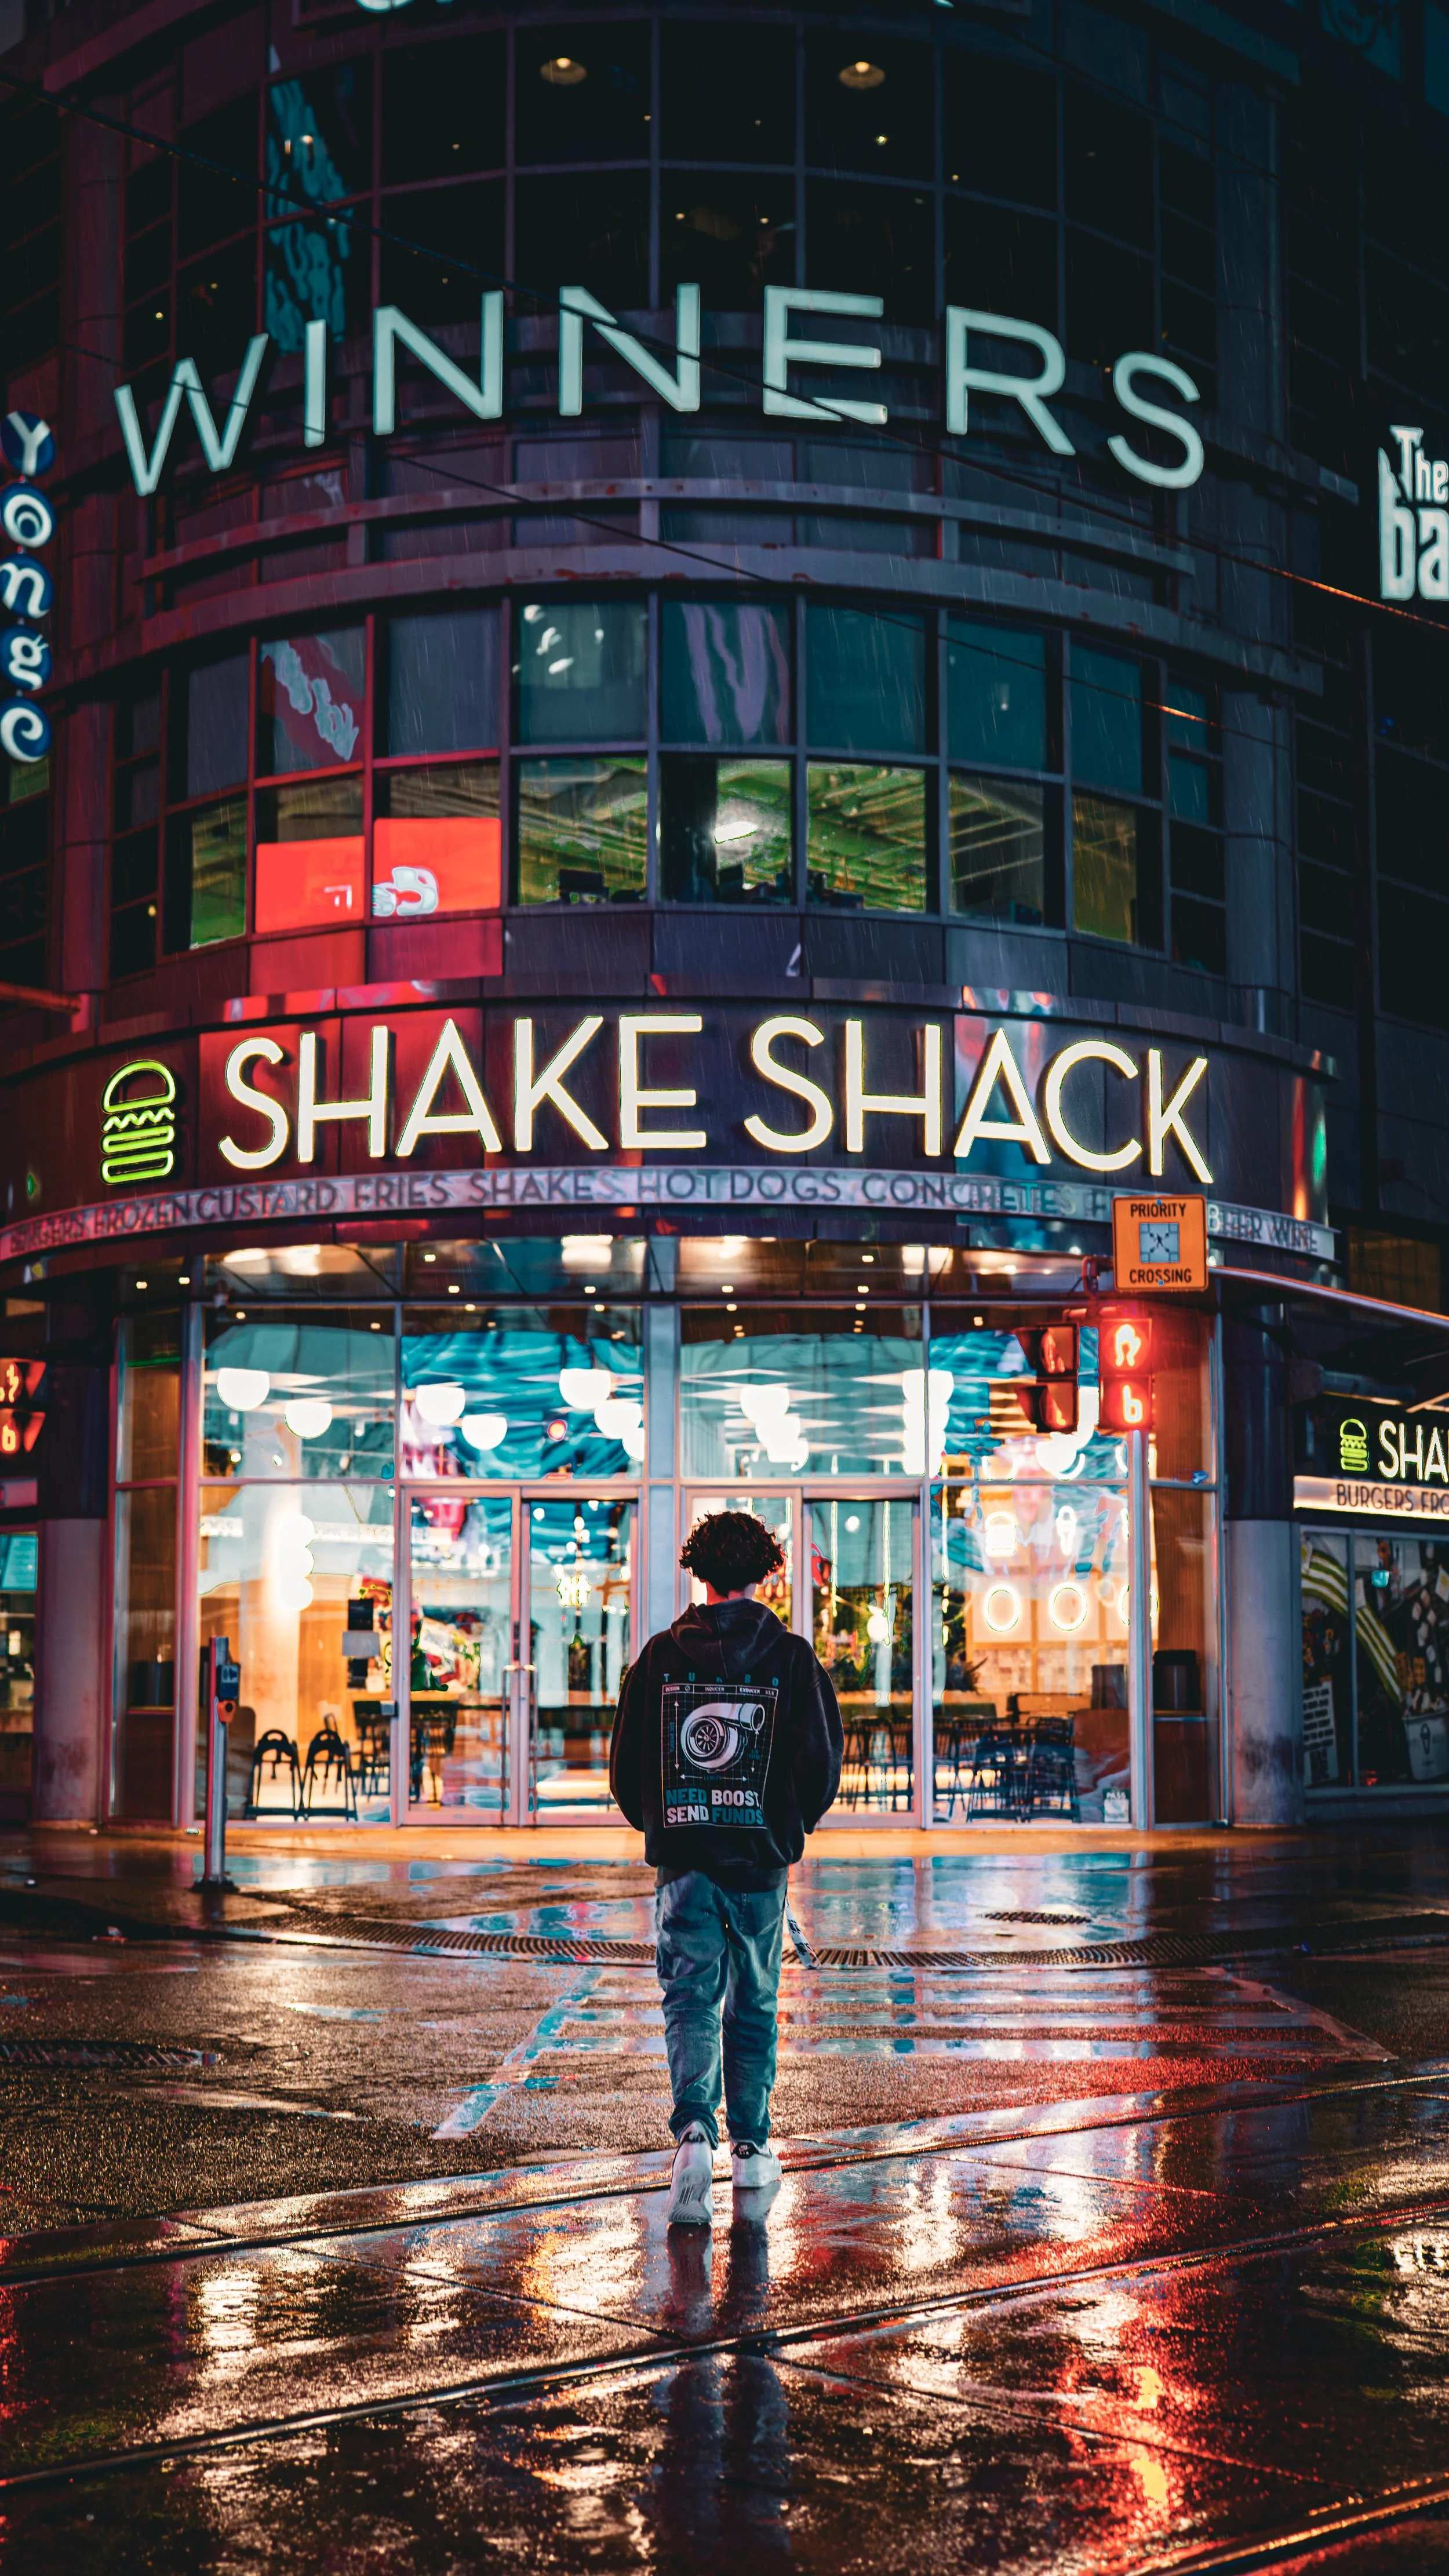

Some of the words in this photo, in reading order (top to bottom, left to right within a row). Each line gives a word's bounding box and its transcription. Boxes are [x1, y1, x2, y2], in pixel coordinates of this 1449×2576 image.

[114, 282, 1204, 496] WINNERS
[1389, 425, 1449, 504] The
[218, 1013, 707, 1170] SHAKE
[744, 1014, 1214, 1184] SHACK
[94, 1193, 191, 1234] FROZEN
[196, 1182, 336, 1222] CUSTARD
[354, 1174, 449, 1209] FRIES
[468, 1169, 616, 1203] SHAKES
[638, 1169, 715, 1199] HOT
[730, 1169, 841, 1202] DOGS
[861, 1172, 1076, 1216] CONCRETES
[1130, 1203, 1186, 1218] PRIORITY
[1129, 1268, 1192, 1284] CROSSING
[1378, 1420, 1449, 1483] SHA
[1337, 1484, 1414, 1512] BURGERS
[666, 1788, 707, 1806] NEED
[667, 1806, 709, 1824] SEND
[712, 1807, 764, 1825] FUNDS
